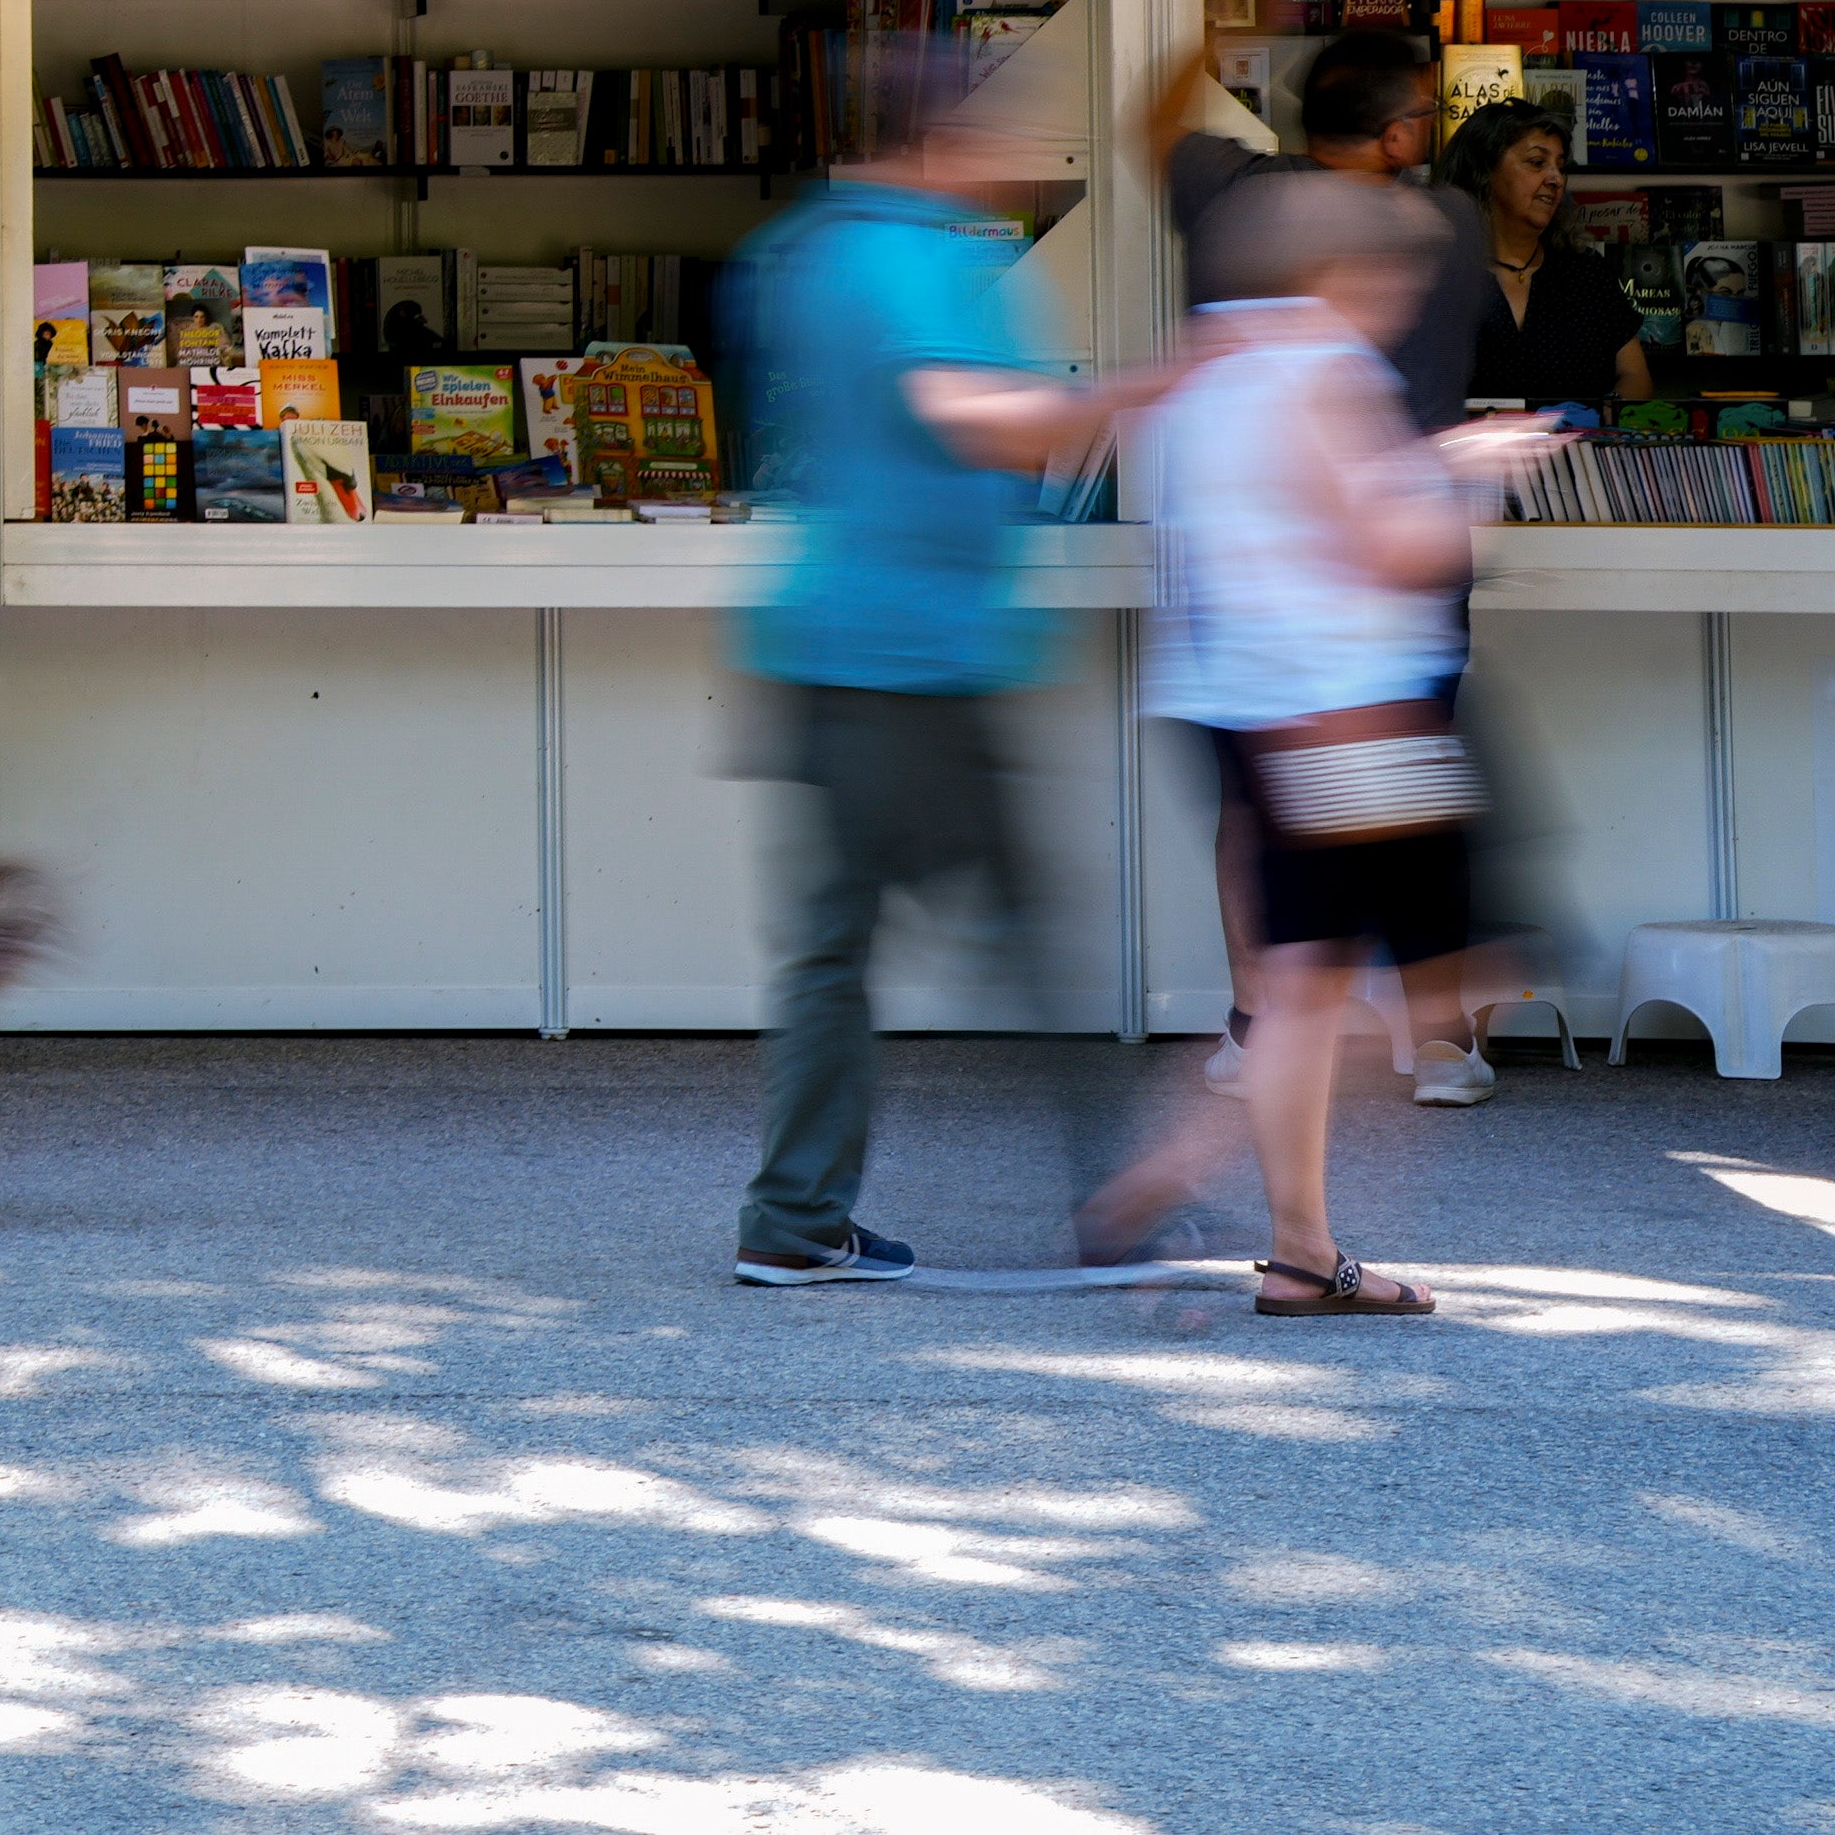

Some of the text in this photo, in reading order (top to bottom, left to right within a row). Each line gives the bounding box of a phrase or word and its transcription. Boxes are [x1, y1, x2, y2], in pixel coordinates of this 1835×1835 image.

[1346, 5, 1405, 17] EMPERADOR
[1650, 12, 1697, 25] COLLEEN
[1641, 24, 1706, 43] HOOVER
[1728, 30, 1788, 43] DENTRO
[1565, 30, 1632, 54] NIEBLA
[1749, 43, 1767, 55] DE
[1450, 83, 1500, 99] ALAS
[1756, 78, 1790, 93] AÚN
[337, 87, 374, 102] Atem
[455, 92, 509, 104] GOETHE
[1748, 93, 1800, 107] SIGUEN
[340, 108, 373, 125] Welt
[1667, 100, 1724, 120] DAMIÁN
[1743, 142, 1809, 155] LISA JEWELL
[948, 224, 1021, 238] Bildermaus
[201, 288, 233, 299] RILKE
[255, 325, 317, 343] Komplett
[258, 340, 313, 360] Kafka
[619, 365, 647, 374] Mein
[282, 374, 317, 383] MISS
[442, 374, 459, 383] Wir
[602, 370, 689, 384] Wimmelhaus
[272, 382, 327, 392] MERKEL
[441, 381, 492, 395] spielen
[431, 393, 510, 408] Einkaufen
[291, 424, 364, 437] JULI ZEH
